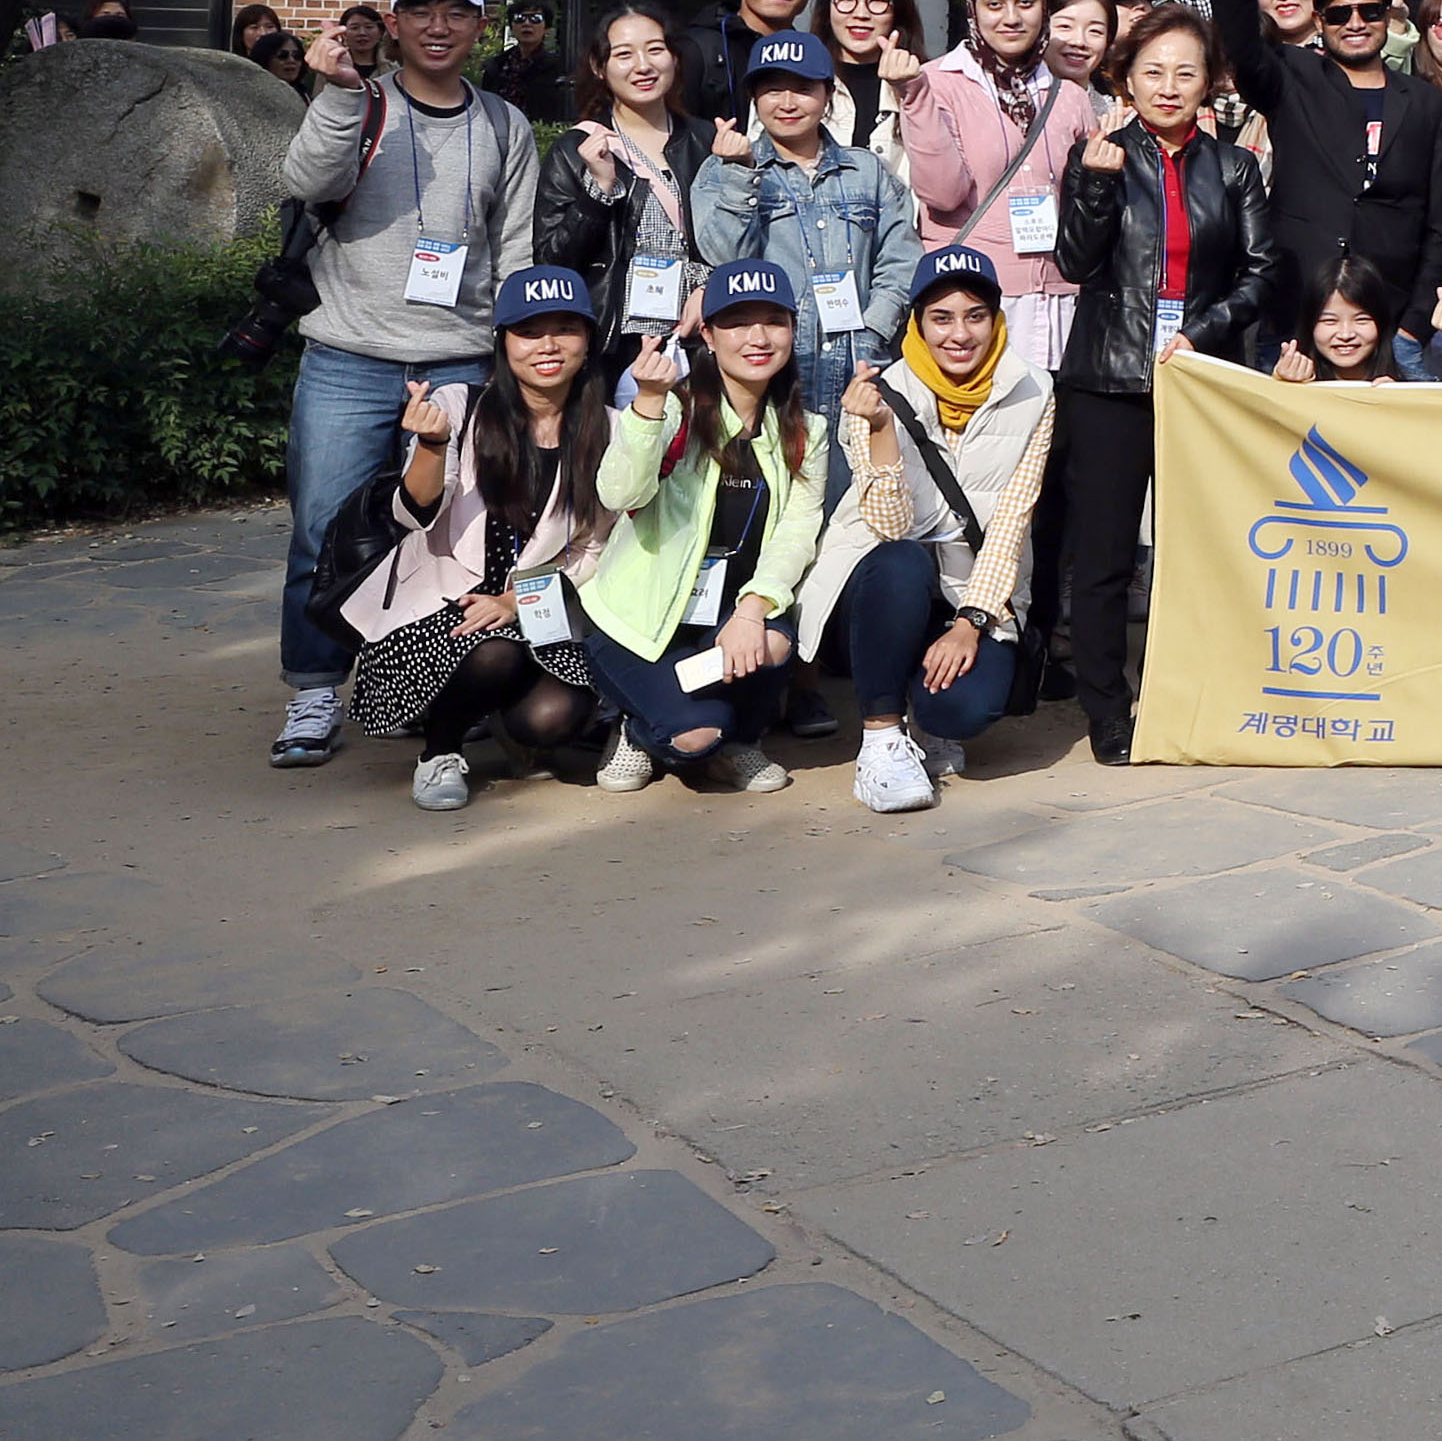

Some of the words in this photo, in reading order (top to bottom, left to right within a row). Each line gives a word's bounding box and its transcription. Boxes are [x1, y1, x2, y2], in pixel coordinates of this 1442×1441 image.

[761, 43, 803, 63] KMU
[935, 253, 980, 273] KMU
[525, 279, 573, 302] KMU
[729, 272, 776, 294] KMU
[1305, 538, 1353, 559] 1899
[1263, 625, 1363, 677] 120
[1236, 711, 1397, 743] 계명대학교
